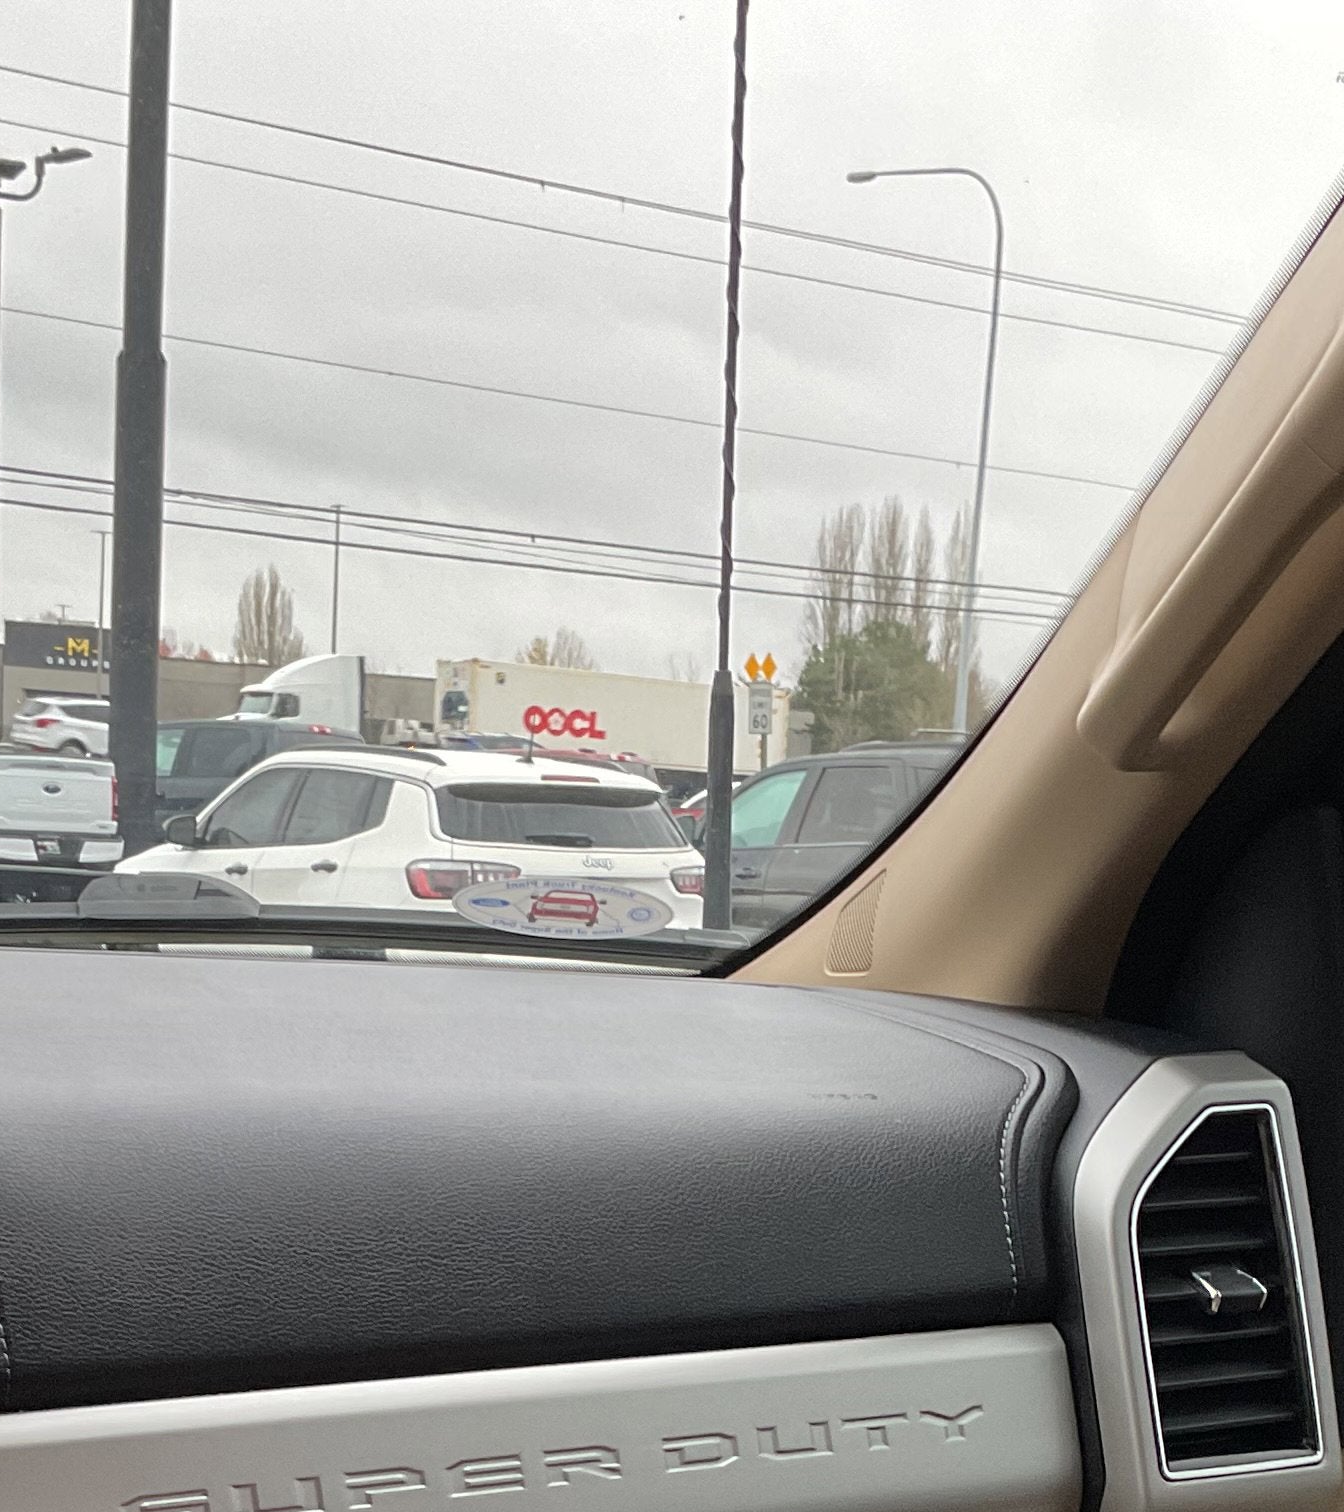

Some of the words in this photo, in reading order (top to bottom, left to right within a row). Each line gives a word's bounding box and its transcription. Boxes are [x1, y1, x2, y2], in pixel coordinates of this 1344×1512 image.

[524, 705, 606, 740] OOCL
[752, 714, 768, 729] 60
[582, 855, 614, 871] Jeep
[660, 1403, 987, 1475] DUTY
